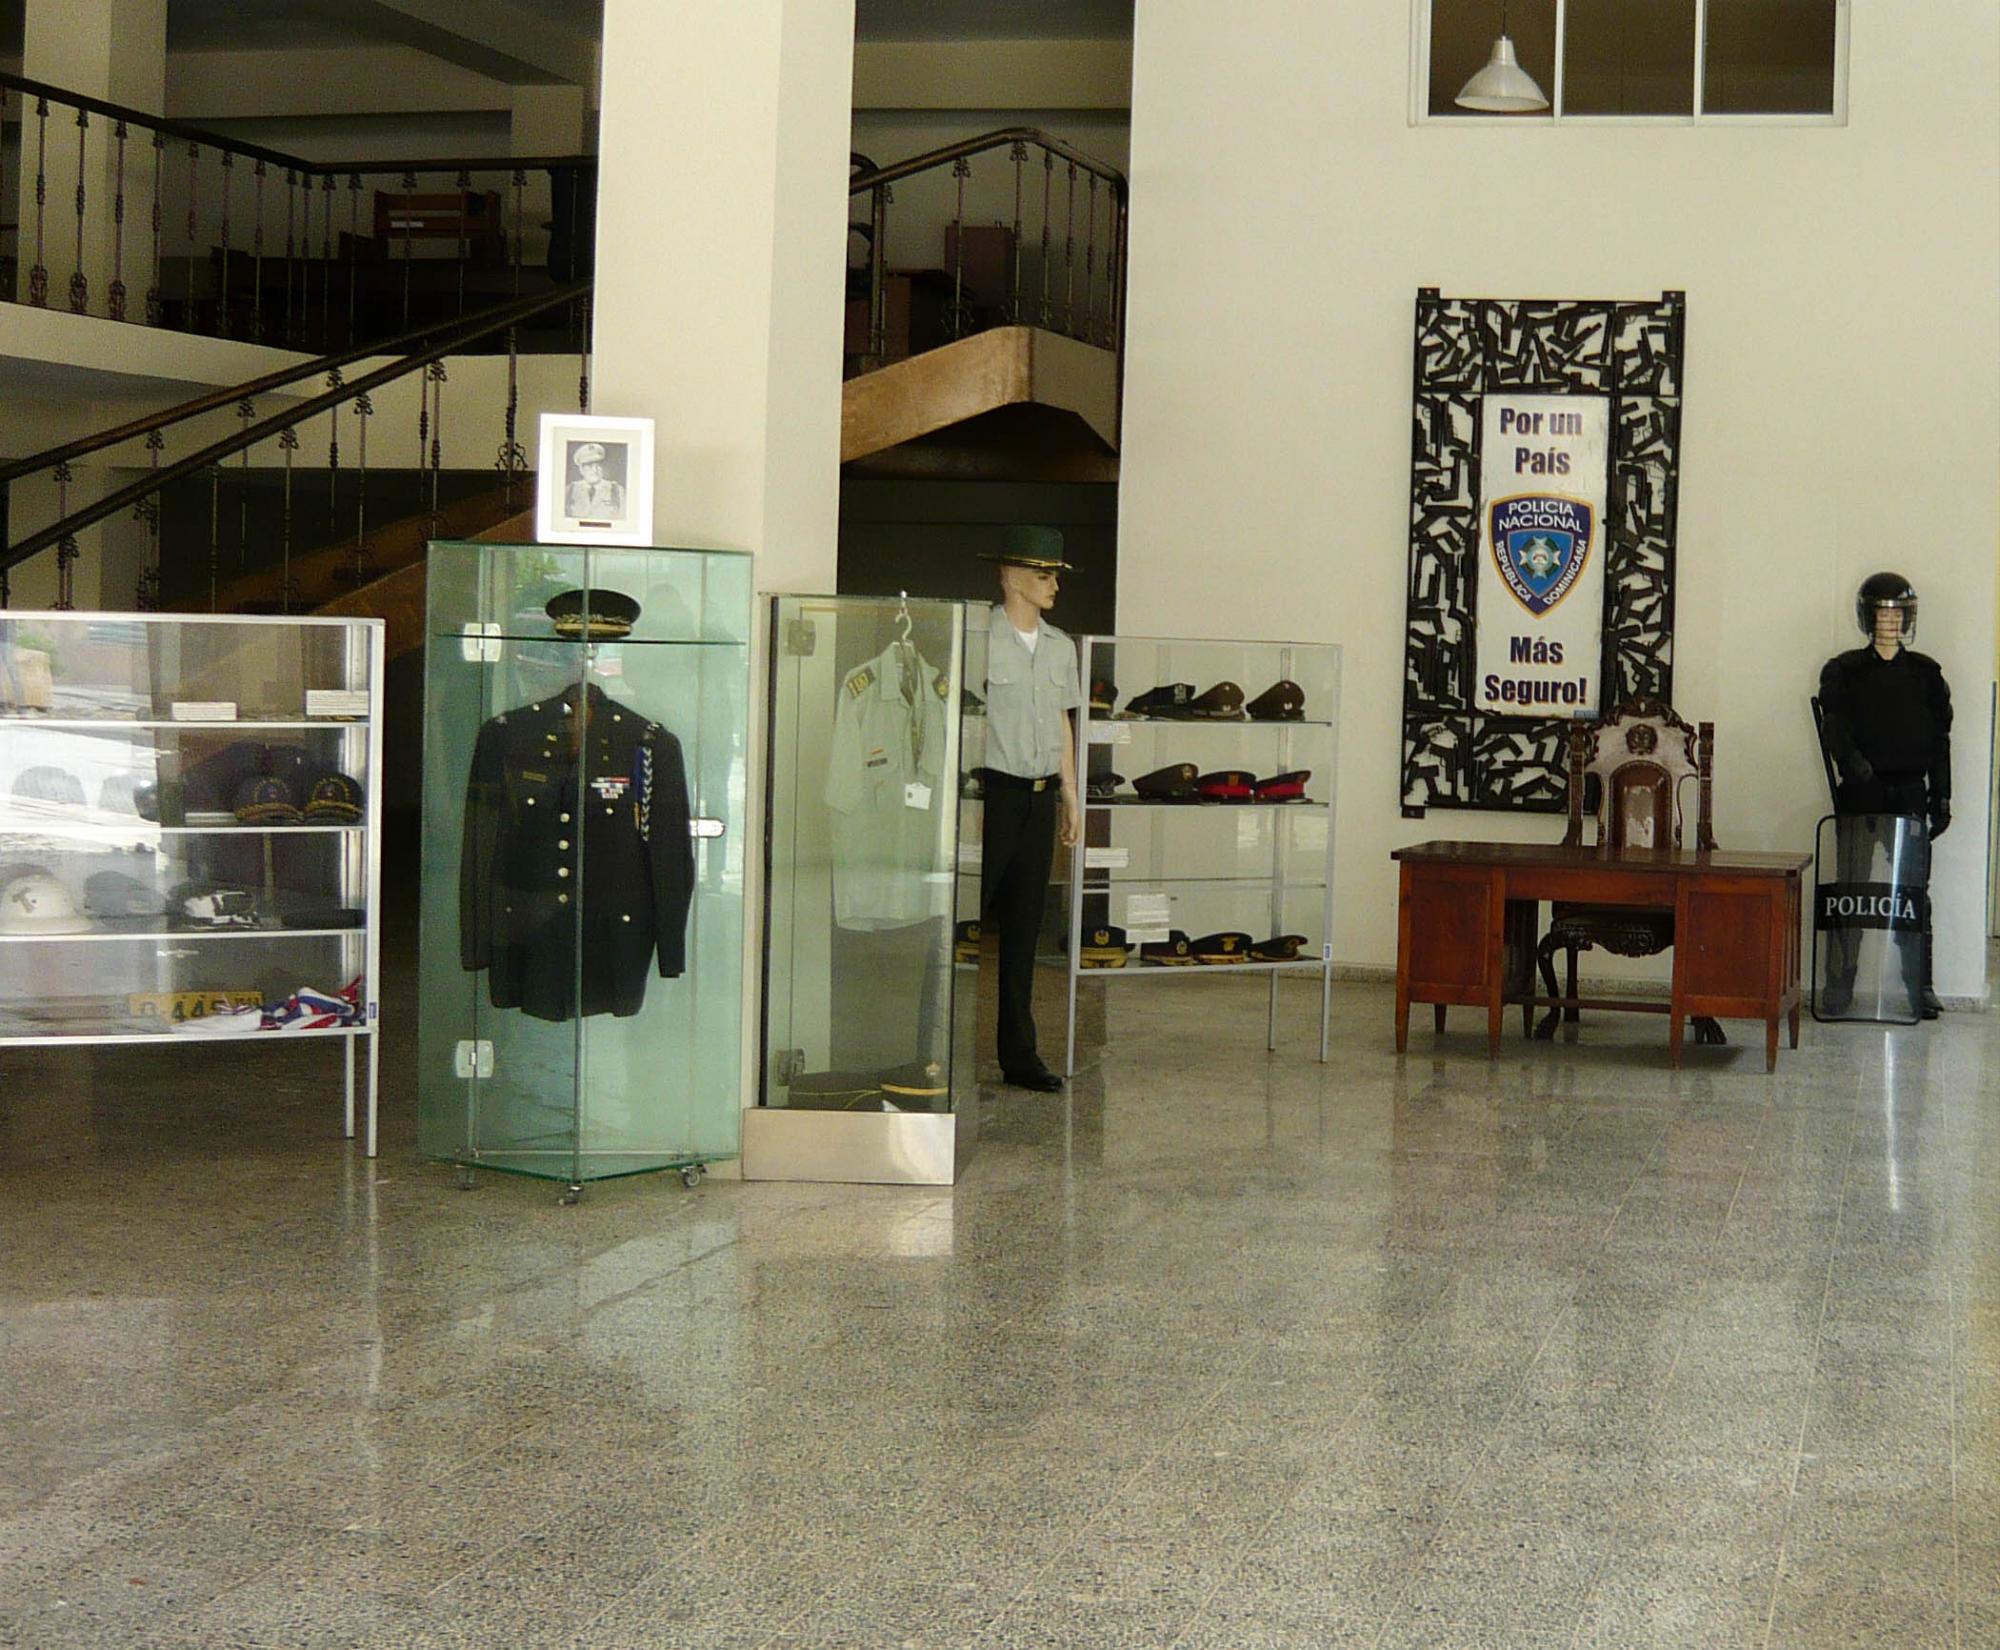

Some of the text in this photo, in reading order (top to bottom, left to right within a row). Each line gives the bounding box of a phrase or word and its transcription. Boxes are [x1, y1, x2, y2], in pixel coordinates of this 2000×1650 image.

[1500, 408, 1583, 436] Por un
[1515, 446, 1570, 475] País
[1508, 500, 1574, 517] POLICIA
[1498, 514, 1583, 533] NACIONAL
[1542, 539, 1587, 605] DOMINICANA
[1510, 636, 1563, 665] Más
[1484, 674, 1587, 706] Seguro!
